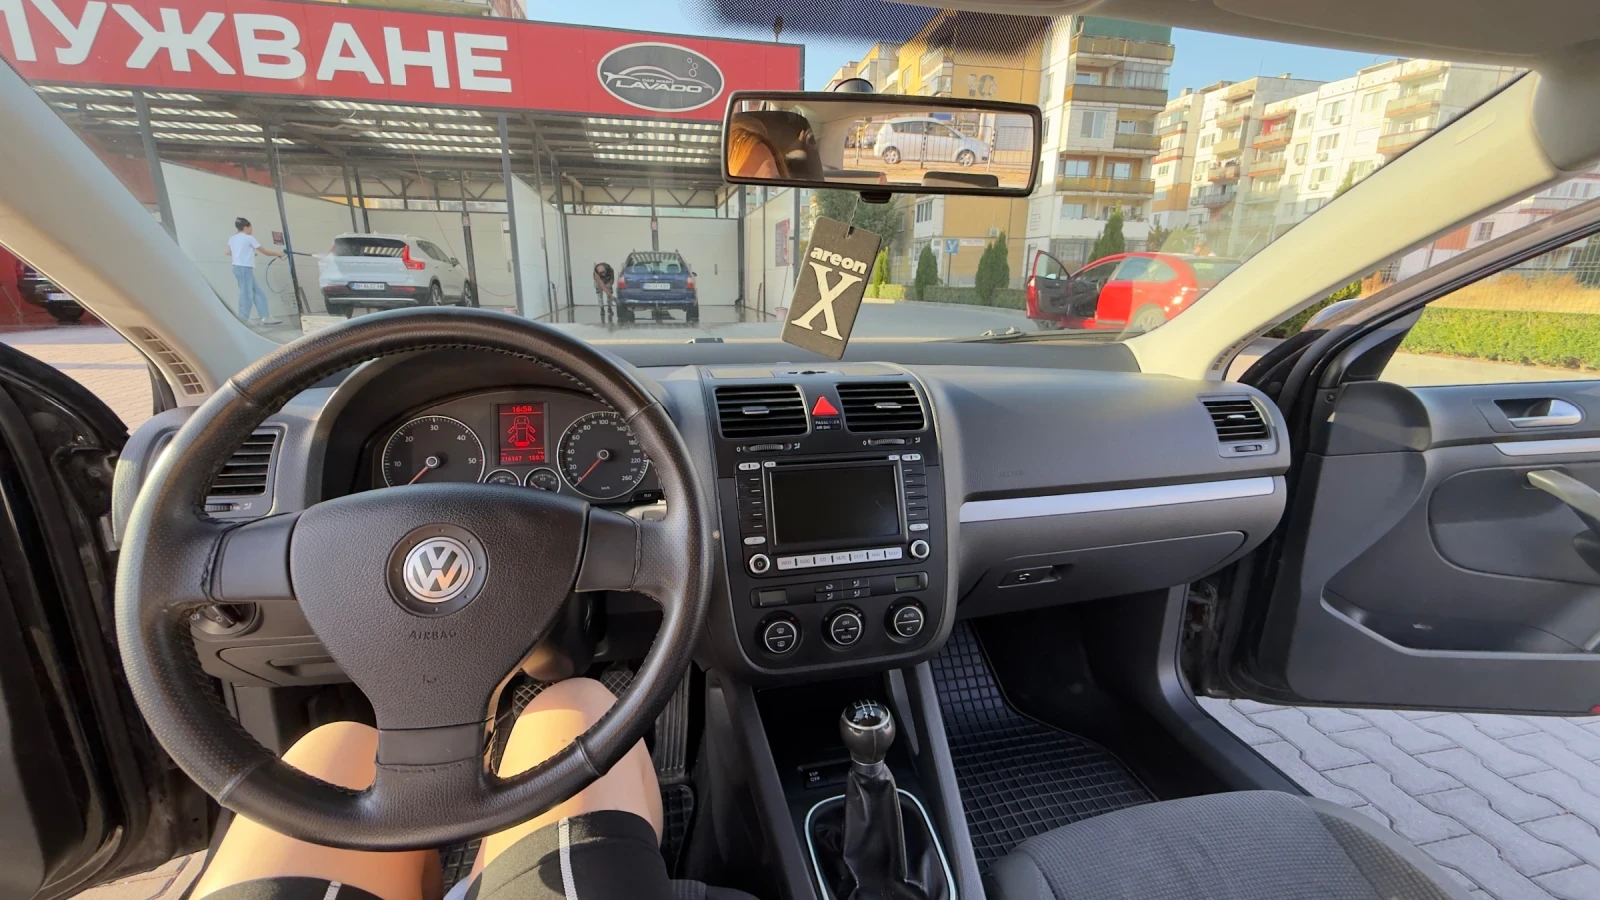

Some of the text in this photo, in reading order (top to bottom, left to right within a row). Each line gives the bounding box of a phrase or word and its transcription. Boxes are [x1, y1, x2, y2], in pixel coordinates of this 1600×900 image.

[615, 80, 703, 93] LAVADO
[810, 246, 868, 275] areon
[791, 261, 862, 341] X
[512, 405, 533, 413] 16:58
[409, 630, 457, 640] AIRBAG
